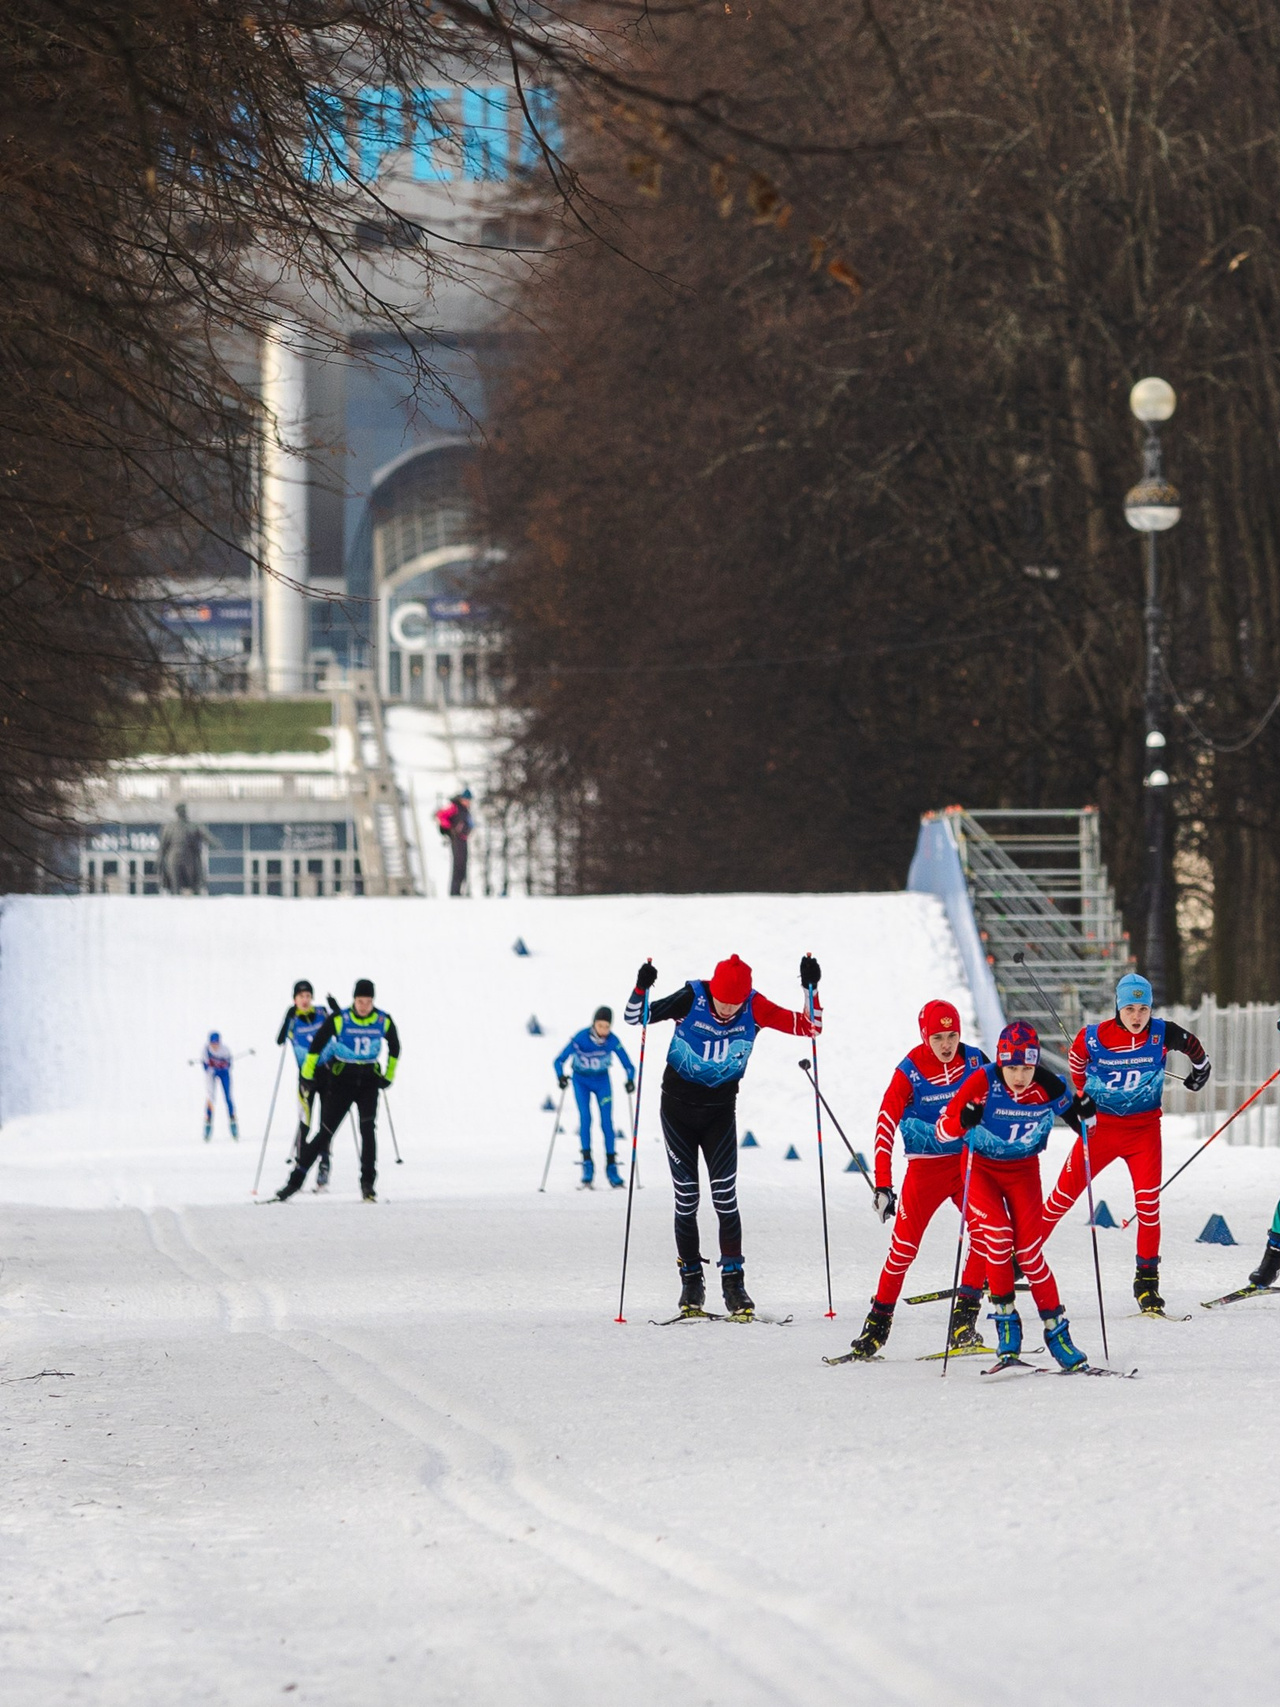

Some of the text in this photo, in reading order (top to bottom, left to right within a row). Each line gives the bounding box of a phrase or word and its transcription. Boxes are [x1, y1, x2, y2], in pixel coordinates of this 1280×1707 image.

[354, 1036, 371, 1056] 13
[1105, 1070, 1142, 1092] 20
[1008, 1121, 1039, 1144] 12
